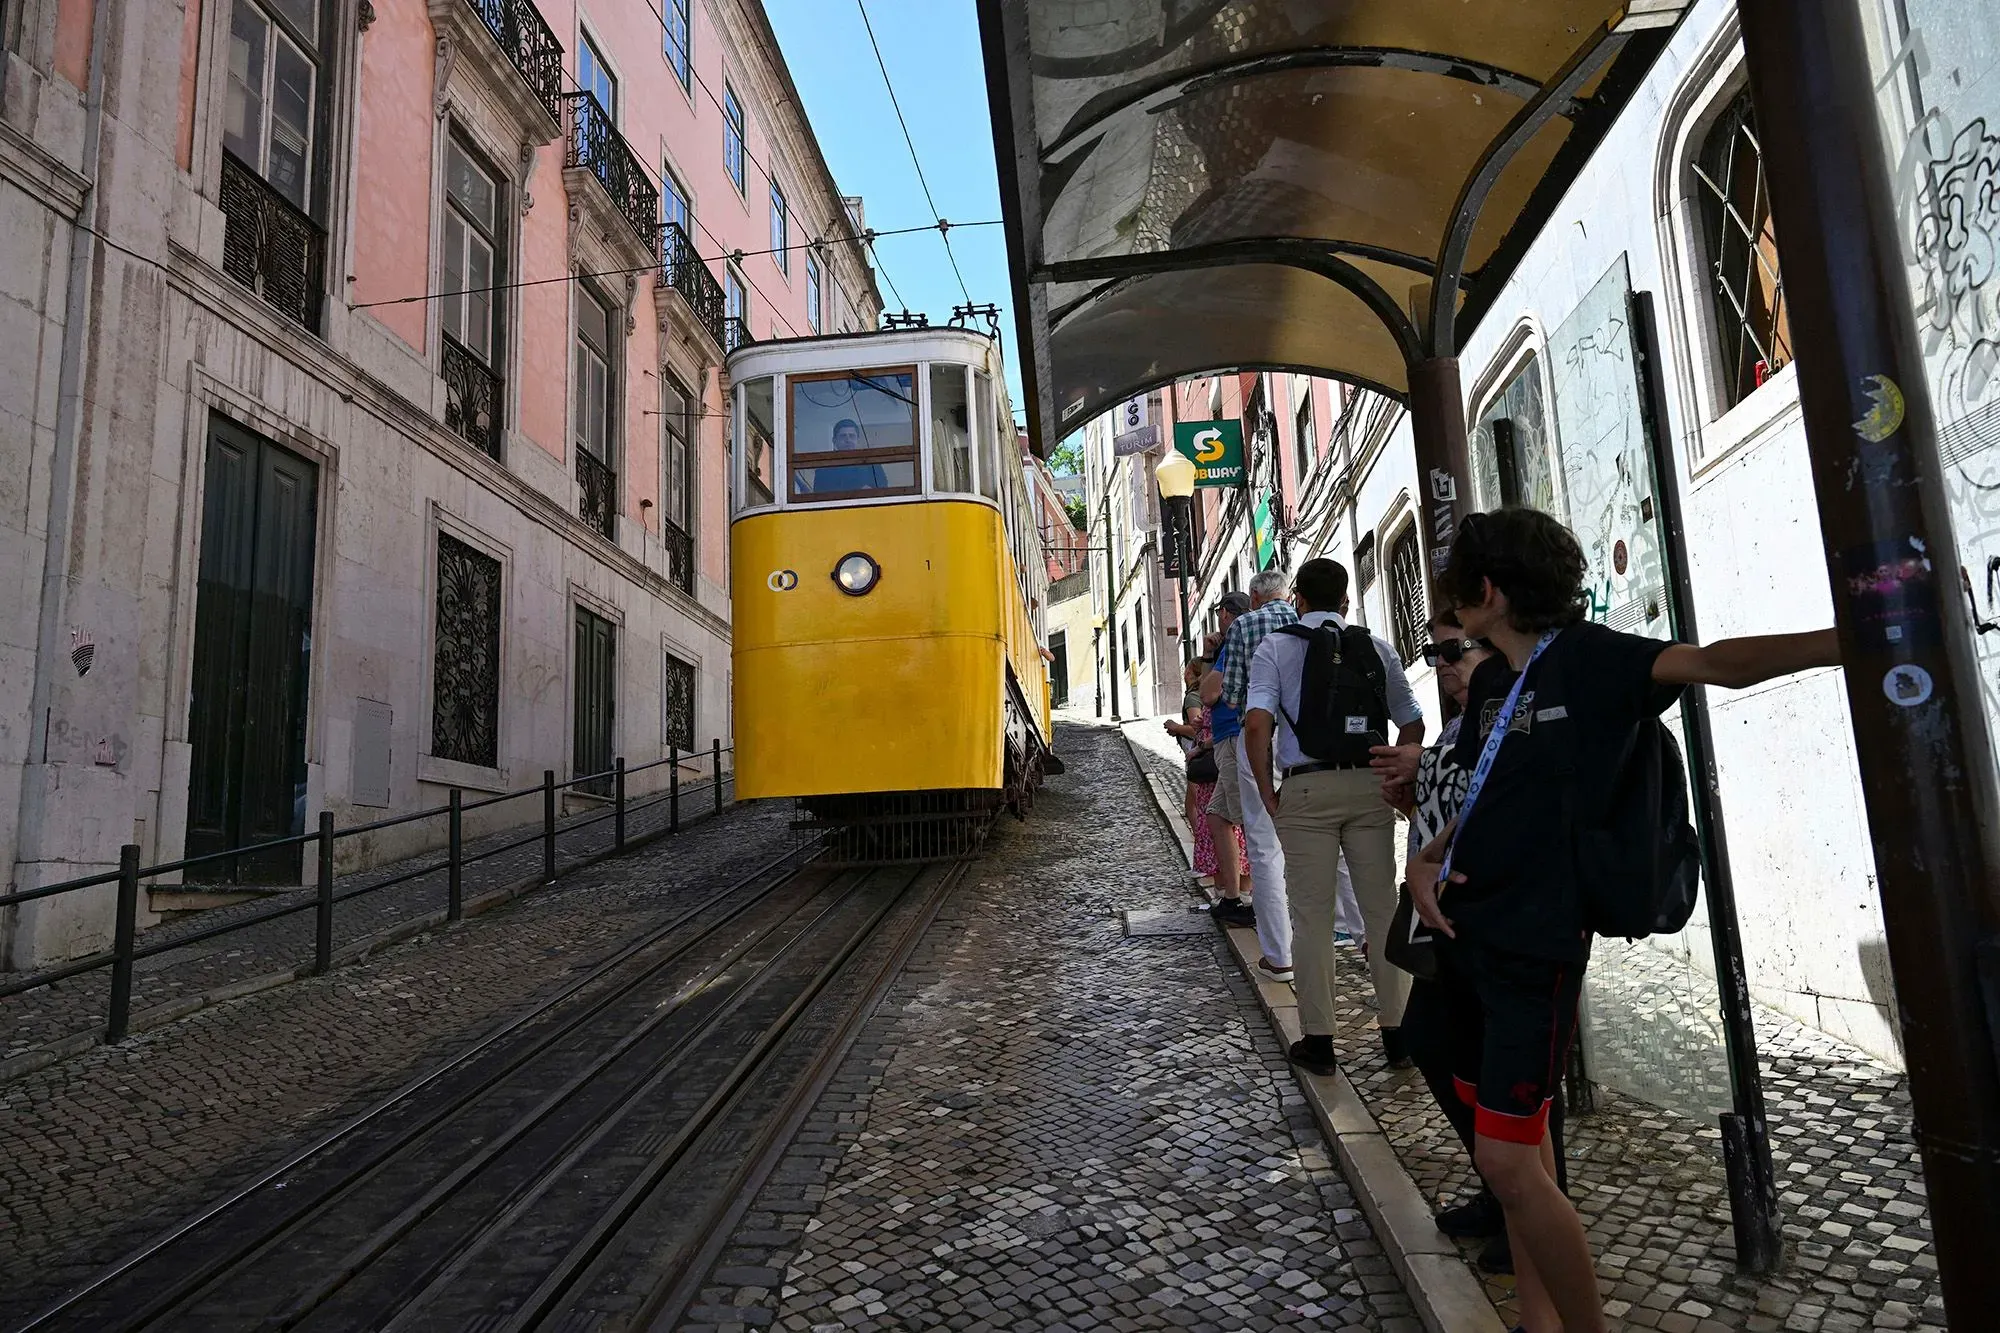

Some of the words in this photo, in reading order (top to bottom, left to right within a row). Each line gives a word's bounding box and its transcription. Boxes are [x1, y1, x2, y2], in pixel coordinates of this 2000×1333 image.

[1119, 434, 1153, 452] TURIM
[1193, 466, 1242, 480] UBWAY
[925, 559, 931, 571] 1
